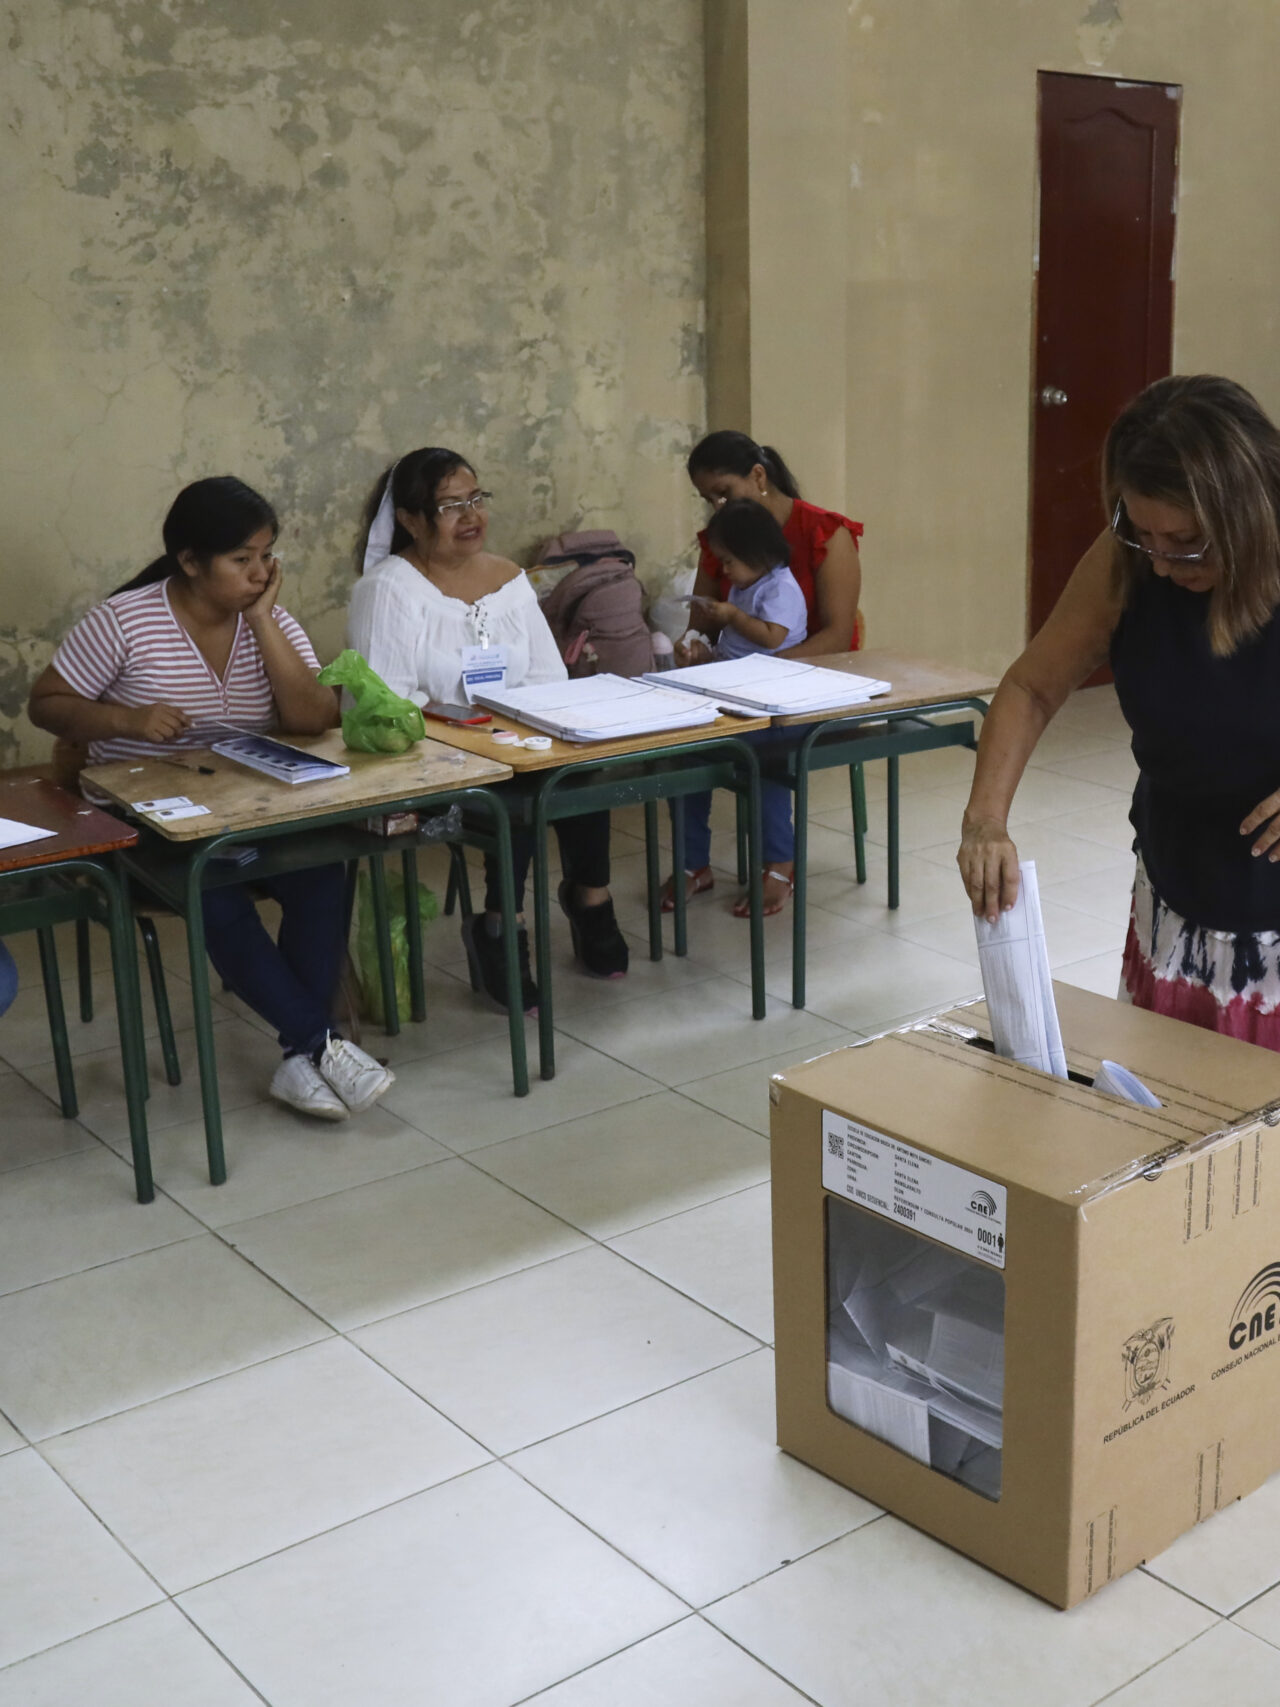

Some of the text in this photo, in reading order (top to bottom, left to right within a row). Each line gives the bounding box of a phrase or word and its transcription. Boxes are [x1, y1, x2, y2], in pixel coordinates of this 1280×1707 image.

[970, 1200, 988, 1215] CNE
[977, 1227, 996, 1248] 0001
[1228, 1302, 1276, 1350] CNE
[1211, 1356, 1243, 1381] CONSEJO
[1243, 1339, 1277, 1362] NACIONAL
[1145, 1406, 1160, 1420] DEL
[1161, 1384, 1196, 1411] ECUADOR
